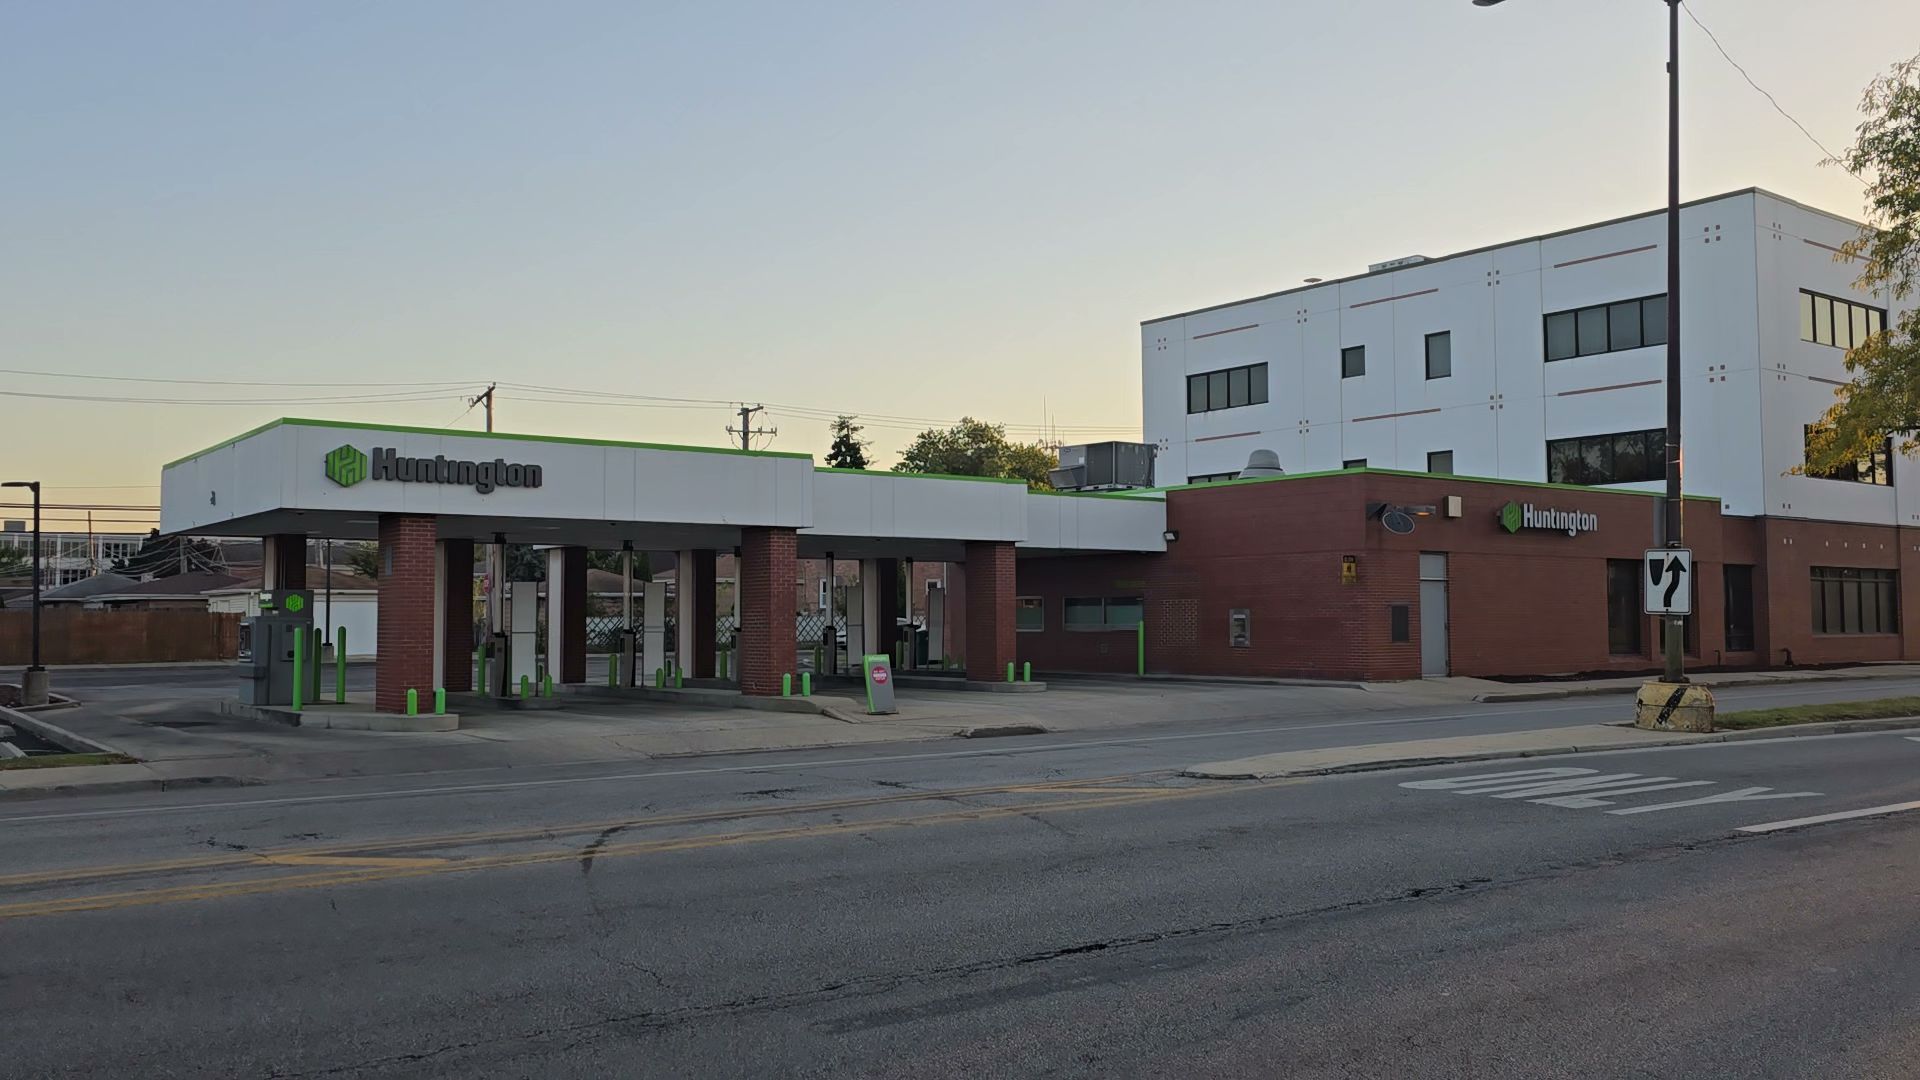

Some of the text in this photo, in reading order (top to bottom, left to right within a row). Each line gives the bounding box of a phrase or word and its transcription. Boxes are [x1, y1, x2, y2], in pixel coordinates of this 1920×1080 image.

[372, 447, 542, 494] Huntington
[1523, 503, 1598, 537] Huntington
[1398, 767, 1825, 816] ONLY
